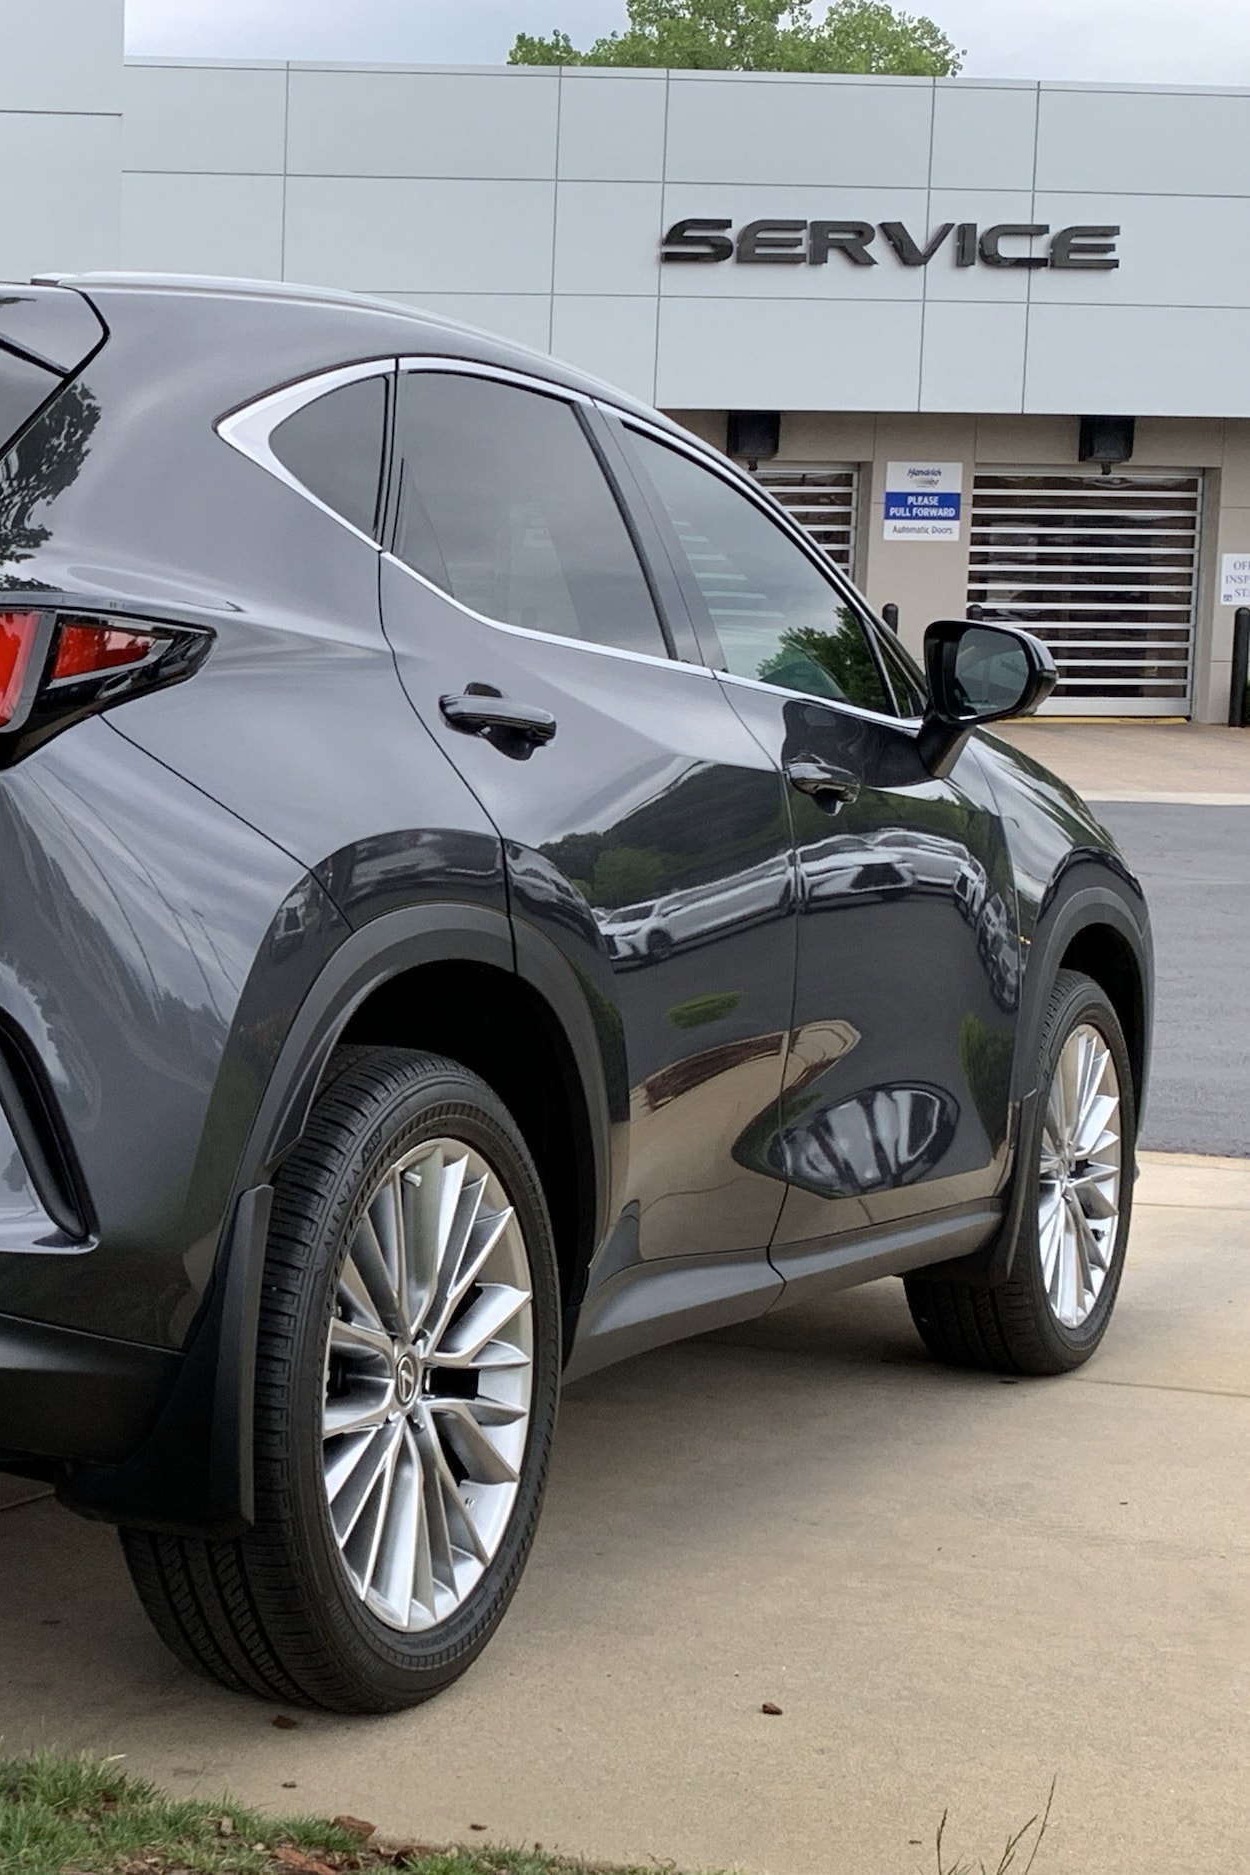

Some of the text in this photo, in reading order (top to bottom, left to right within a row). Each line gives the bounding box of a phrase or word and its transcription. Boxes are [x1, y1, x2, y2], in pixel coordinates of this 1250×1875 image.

[660, 218, 1121, 269] SERVICE
[907, 468, 942, 478] Hendrick
[907, 496, 939, 506] PLEASE
[889, 507, 956, 518] PULL FORWARD
[892, 525, 953, 535] Automatic Doors
[1233, 560, 1250, 571] OF
[1234, 588, 1250, 598] ST
